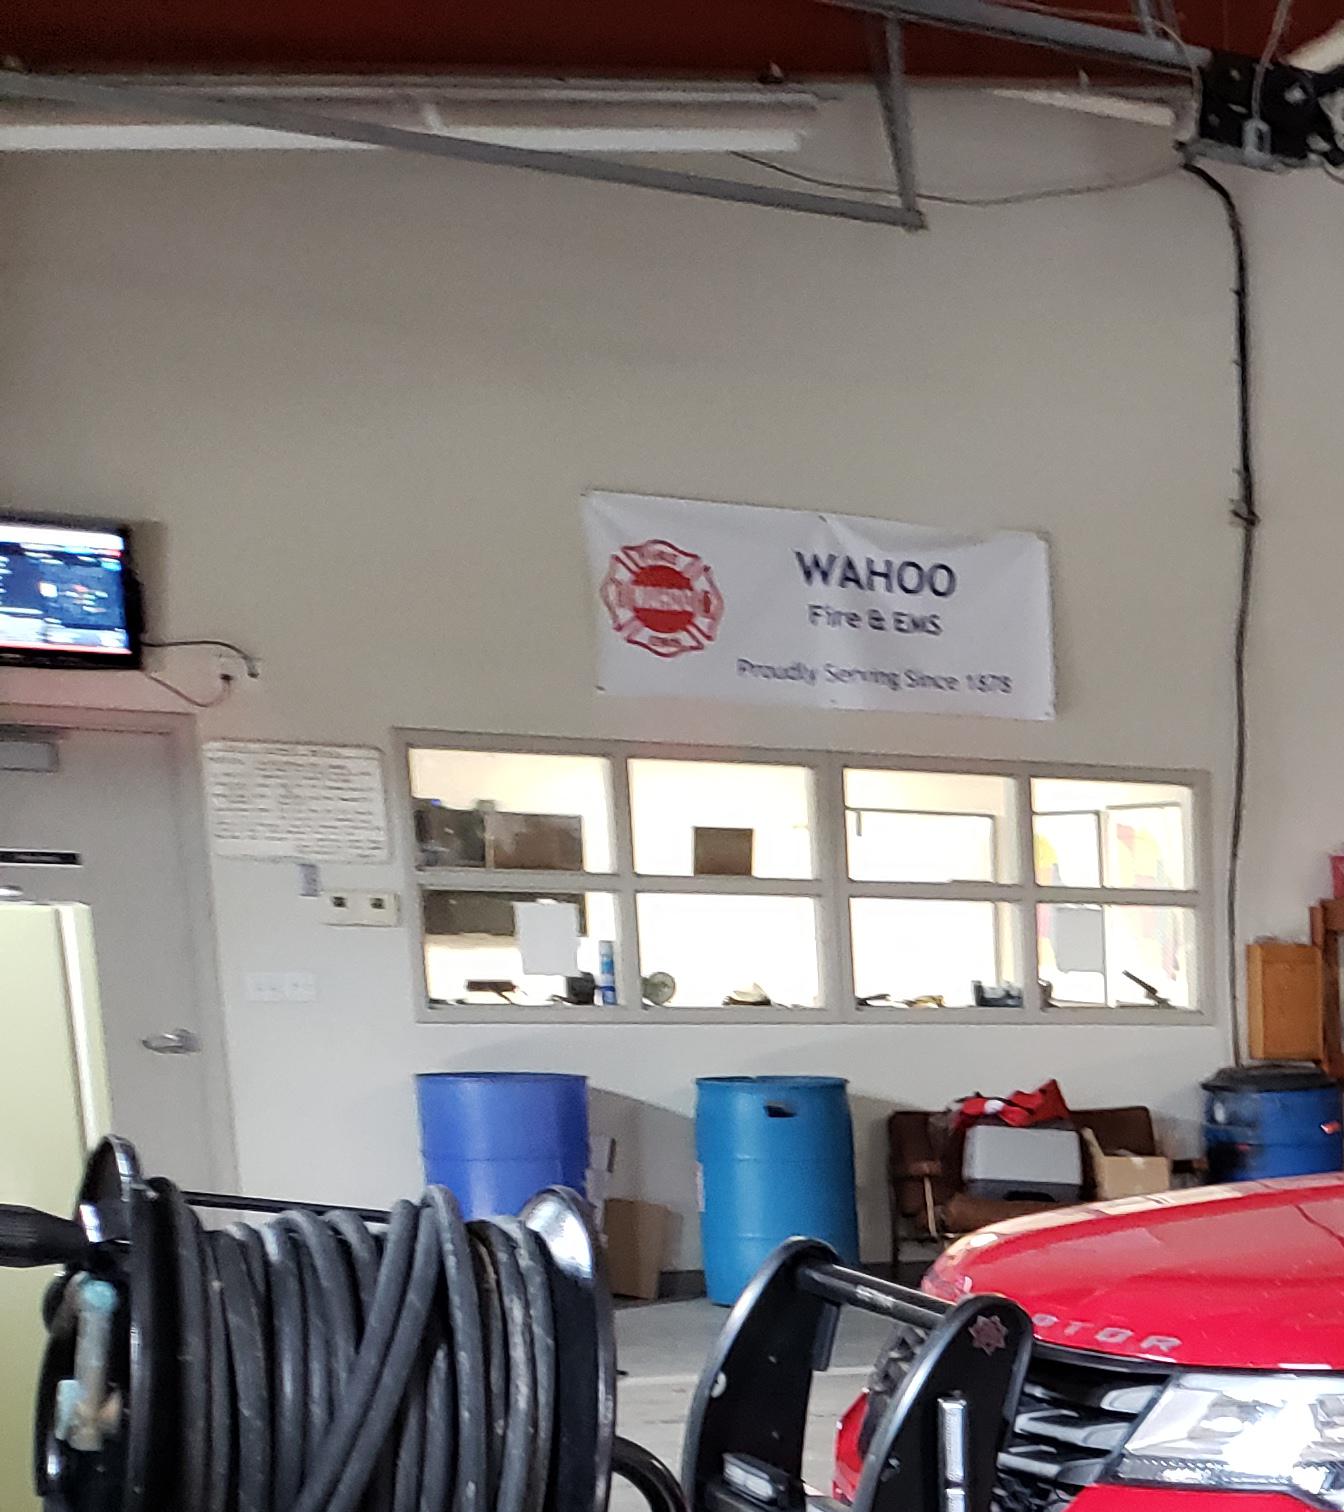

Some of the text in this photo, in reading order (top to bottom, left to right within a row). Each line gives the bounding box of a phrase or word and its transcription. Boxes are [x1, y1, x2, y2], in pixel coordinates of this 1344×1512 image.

[795, 550, 957, 597] WAHOO
[808, 603, 944, 637] Fire & EMS
[736, 658, 816, 687] Proudly
[823, 663, 901, 692] Serving
[903, 669, 961, 692] Since
